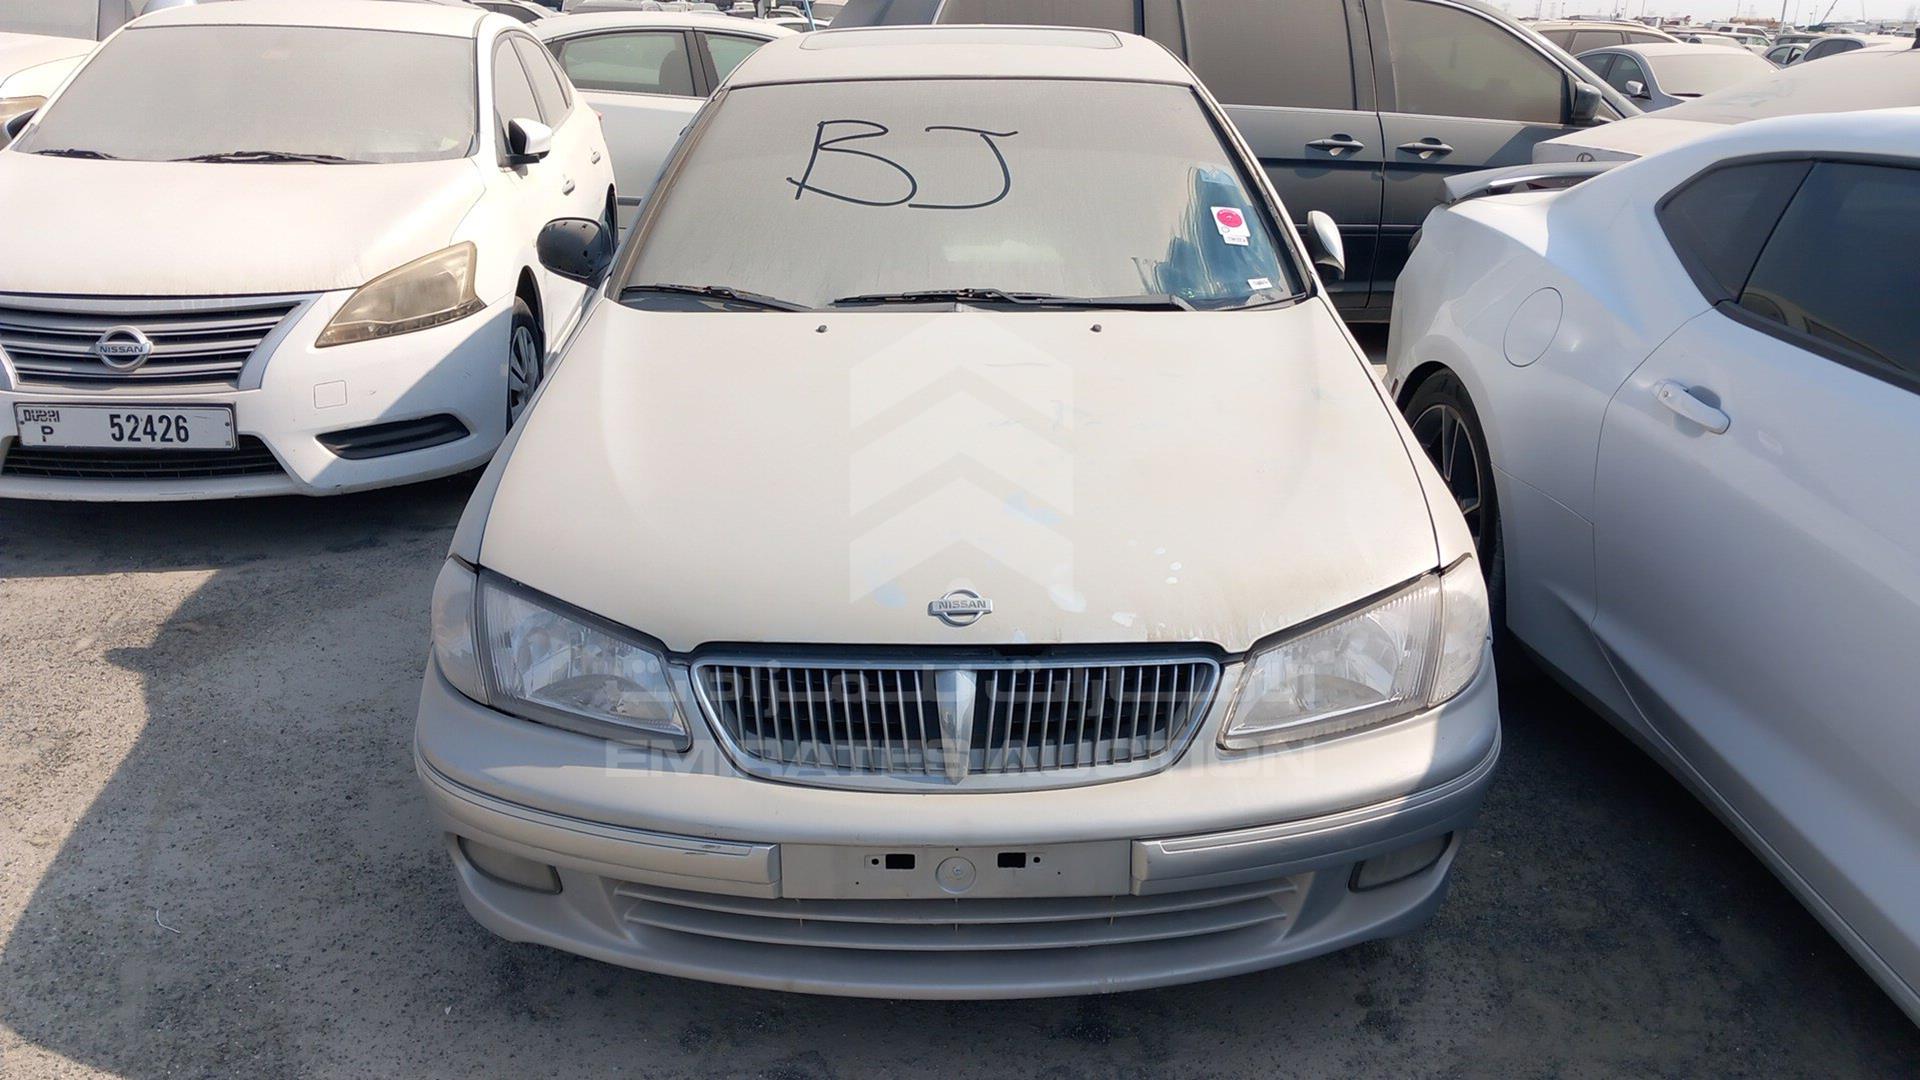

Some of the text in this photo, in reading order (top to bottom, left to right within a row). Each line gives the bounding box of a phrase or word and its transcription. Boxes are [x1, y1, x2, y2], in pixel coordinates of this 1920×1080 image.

[99, 345, 144, 353] NISSAN
[109, 414, 190, 443] 52426
[938, 600, 987, 609] NISSAN
